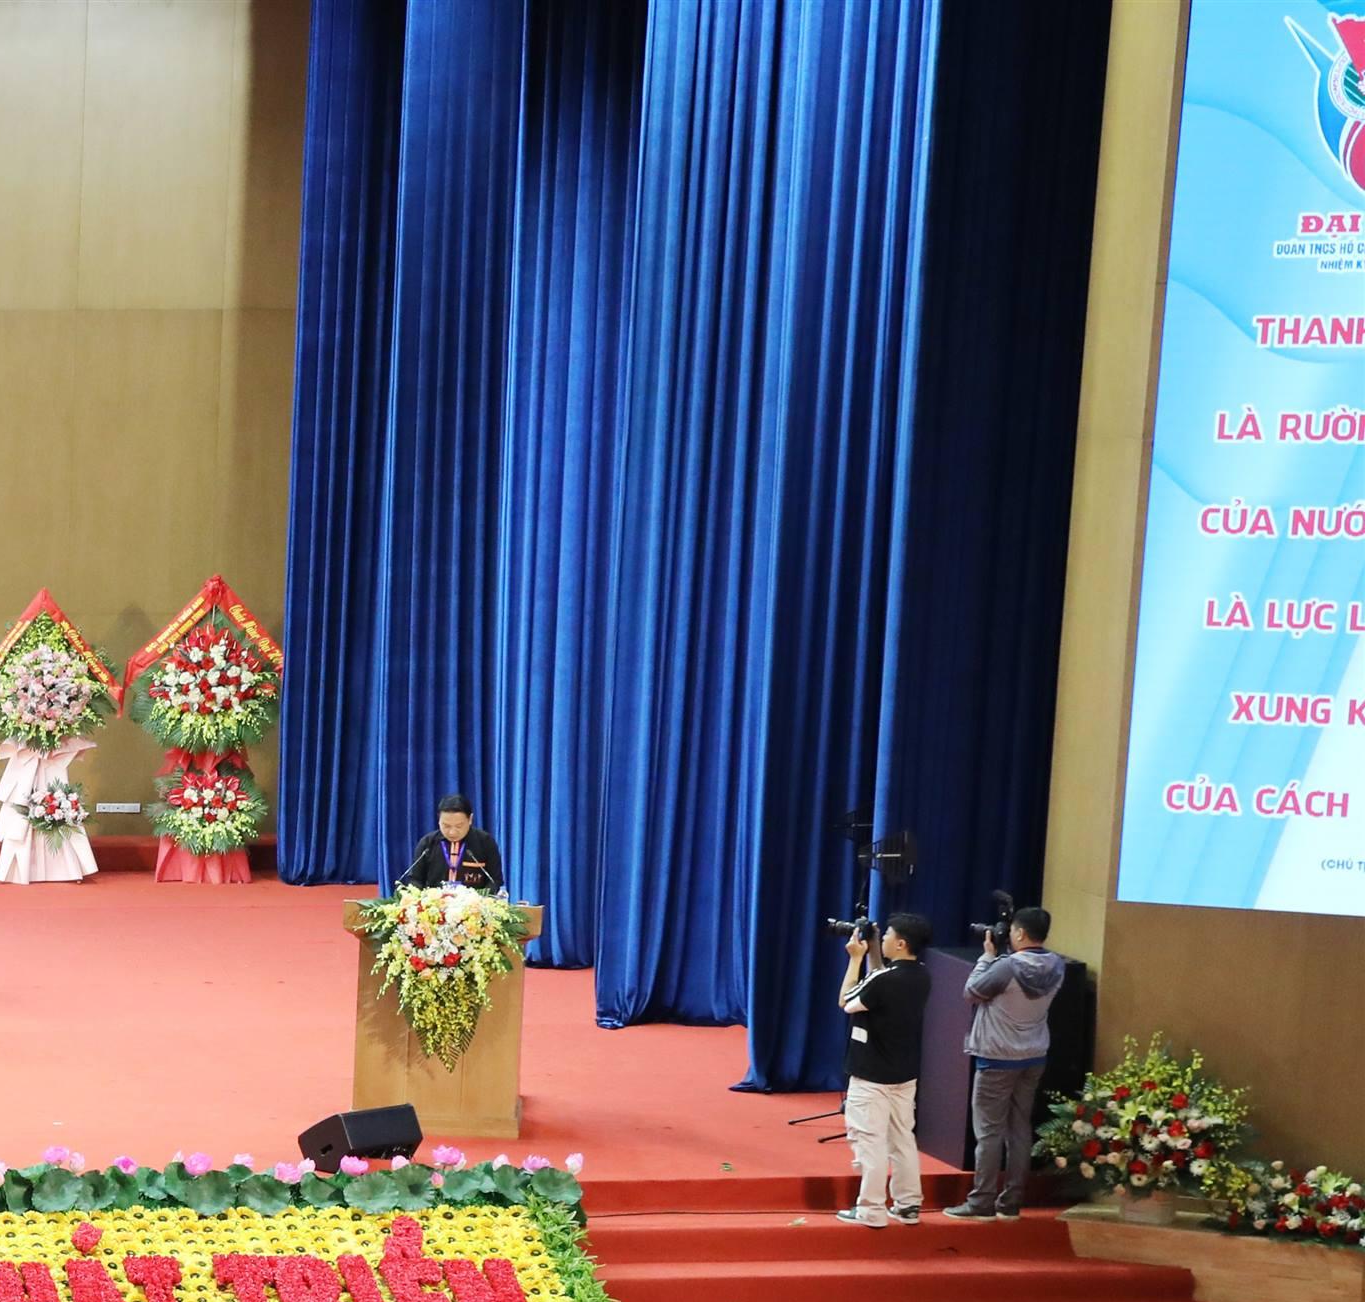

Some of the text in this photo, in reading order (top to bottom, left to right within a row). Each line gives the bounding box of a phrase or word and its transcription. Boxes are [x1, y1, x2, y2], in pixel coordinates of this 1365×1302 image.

[1301, 214, 1361, 238] ĐẠI
[1309, 242, 1336, 255] TNCS
[1217, 407, 1262, 441] LÀ
[1201, 499, 1275, 536] CỦA
[1206, 594, 1250, 627] LÀ
[1267, 601, 1335, 637] LỰC
[1232, 694, 1332, 724] XUNG
[1166, 777, 1350, 818] CỦA CÁCH
